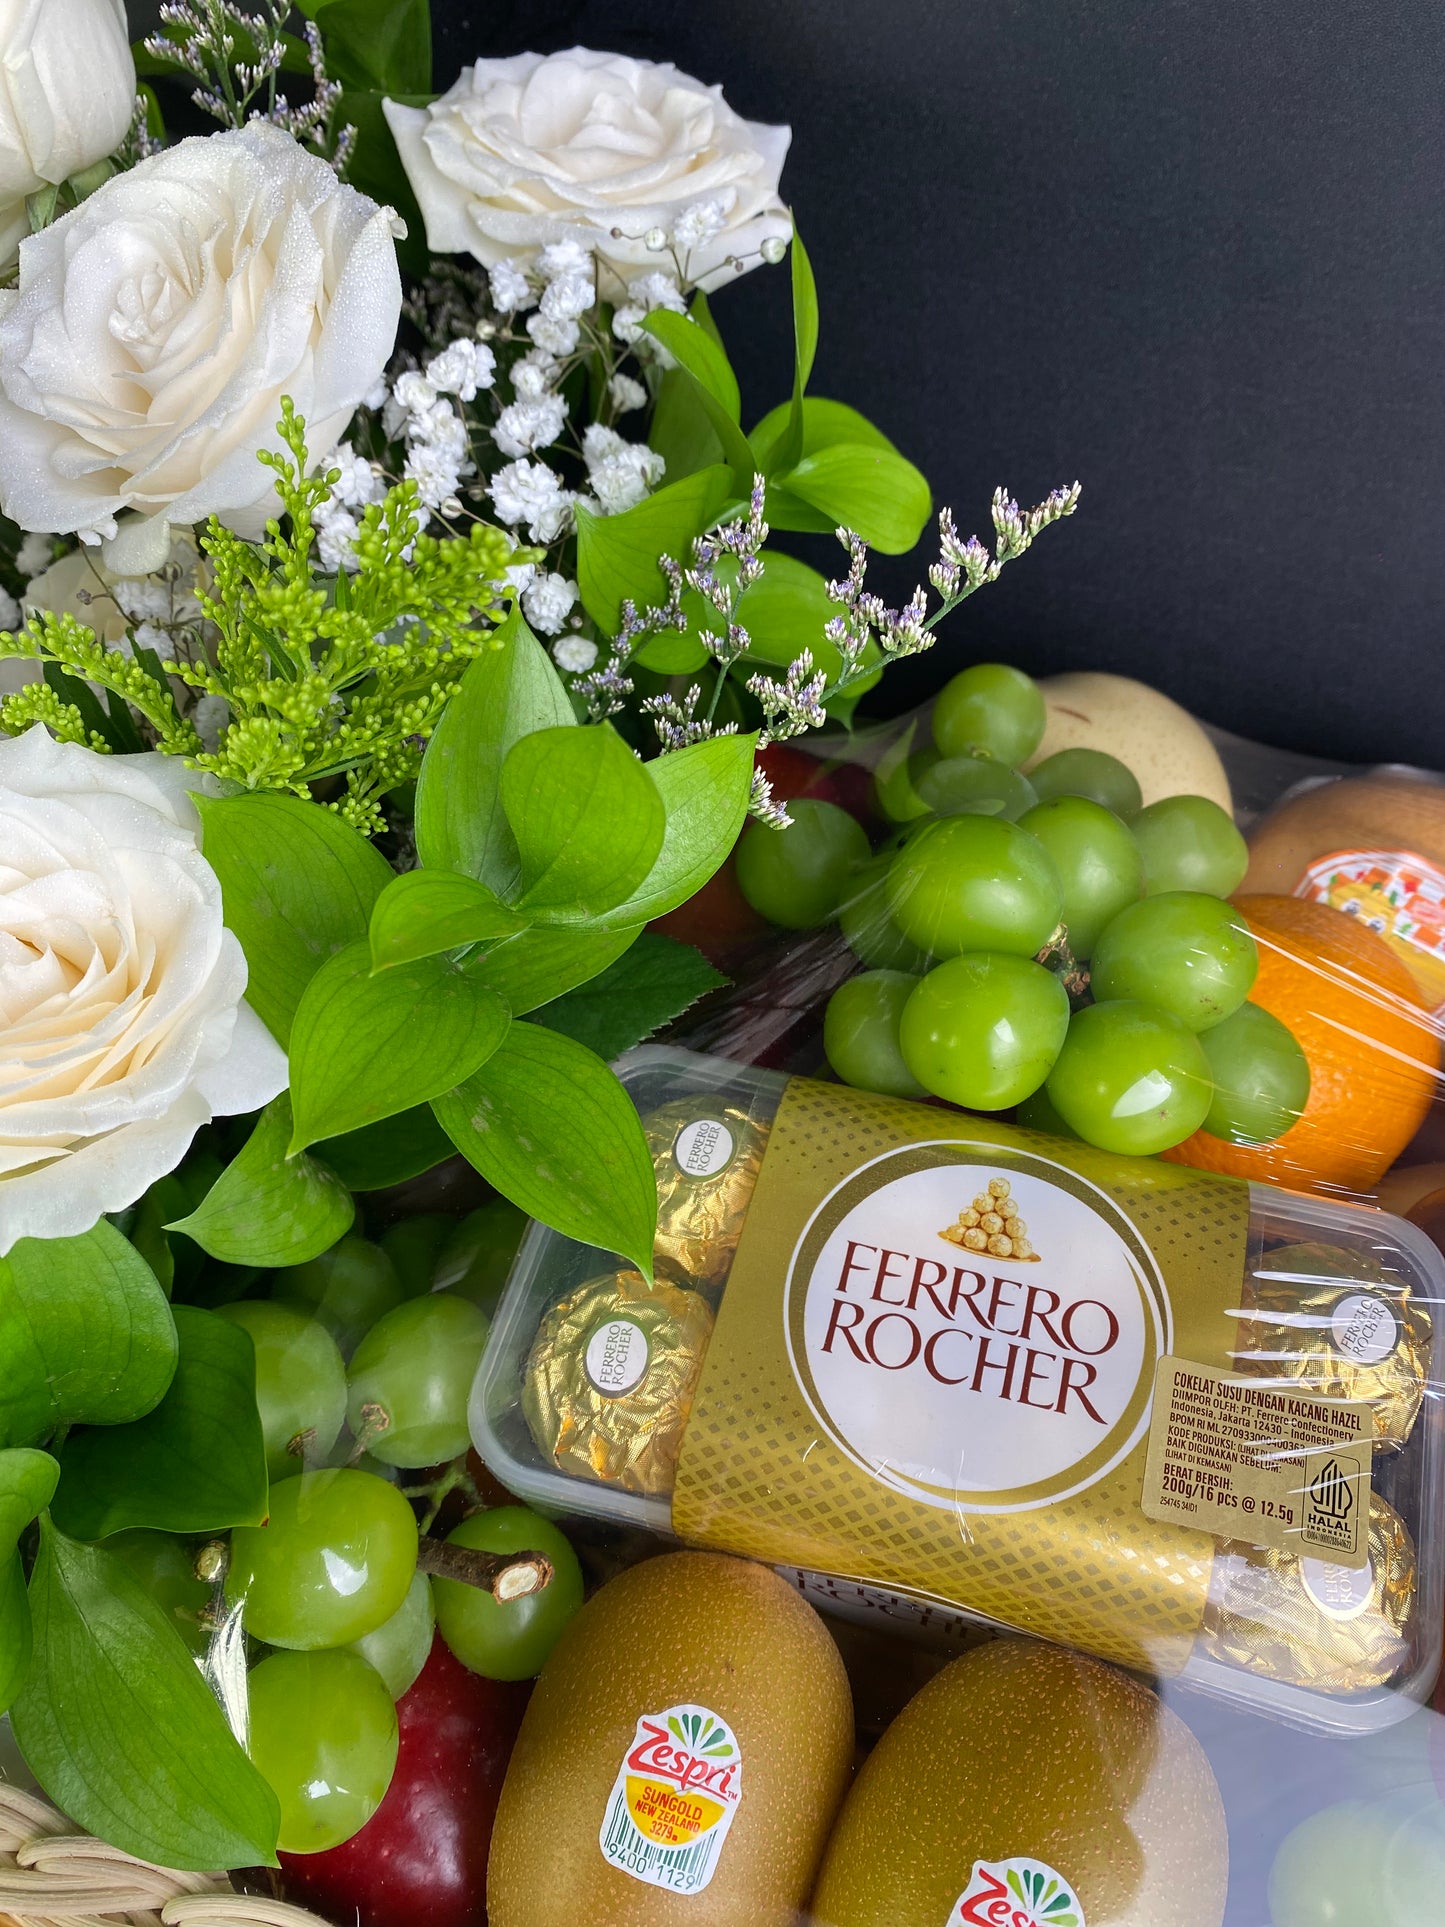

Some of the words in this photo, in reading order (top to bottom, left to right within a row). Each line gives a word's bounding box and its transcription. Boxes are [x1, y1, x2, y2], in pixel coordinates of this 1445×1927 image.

[686, 1122, 710, 1169] FERRERO
[697, 1126, 721, 1172] ROCHER
[836, 1240, 1119, 1356] FERRERO
[600, 1324, 620, 1384] FERRERO
[611, 1326, 633, 1385] ROCHER
[821, 1298, 1108, 1425] ROCHER
[1169, 1412, 1195, 1427] BPOM
[1197, 1418, 1206, 1429] RI
[1207, 1421, 1220, 1433] ML
[1171, 1399, 1216, 1420] Indonesia,
[1218, 1411, 1251, 1427] Jakarta
[1253, 1420, 1282, 1435] 12430
[1291, 1428, 1335, 1448] Indonesia
[1172, 1388, 1211, 1406] DIIMPOR
[1241, 1405, 1254, 1417] PT.
[1291, 1417, 1354, 1442] Confectionery
[1174, 1371, 1215, 1395] COKELAT
[1217, 1382, 1242, 1402] SUSU
[1245, 1389, 1285, 1413] DENGAN
[1288, 1399, 1328, 1423] KACANG
[1331, 1409, 1361, 1431] HAZEL
[1165, 1448, 1187, 1462] (LIHAT
[1188, 1455, 1195, 1463] DI
[1196, 1456, 1232, 1473] KEMASAN)
[1166, 1436, 1186, 1450] BAIK
[1188, 1441, 1238, 1463] DIGUNAKAN
[1168, 1425, 1190, 1439] KODE
[1192, 1431, 1236, 1451] PRODUKSI:
[1164, 1463, 1193, 1480] BERAT
[1196, 1470, 1233, 1490] BERSIH:
[1162, 1475, 1214, 1501] 200g/16
[1217, 1491, 1238, 1507] pcs
[1242, 1496, 1255, 1513] @
[1261, 1500, 1293, 1525] 12.5g
[1308, 1513, 1351, 1533] HALAL
[1307, 1524, 1351, 1539] INDONESIA
[627, 1720, 737, 1803] Zespri
[635, 1800, 657, 1817] NEW
[657, 1809, 701, 1833] ZEALAND
[642, 1785, 703, 1821] SUNGOLD
[650, 1821, 673, 1840] 3279
[608, 1842, 647, 1874] 9400
[657, 1864, 696, 1890] 1129
